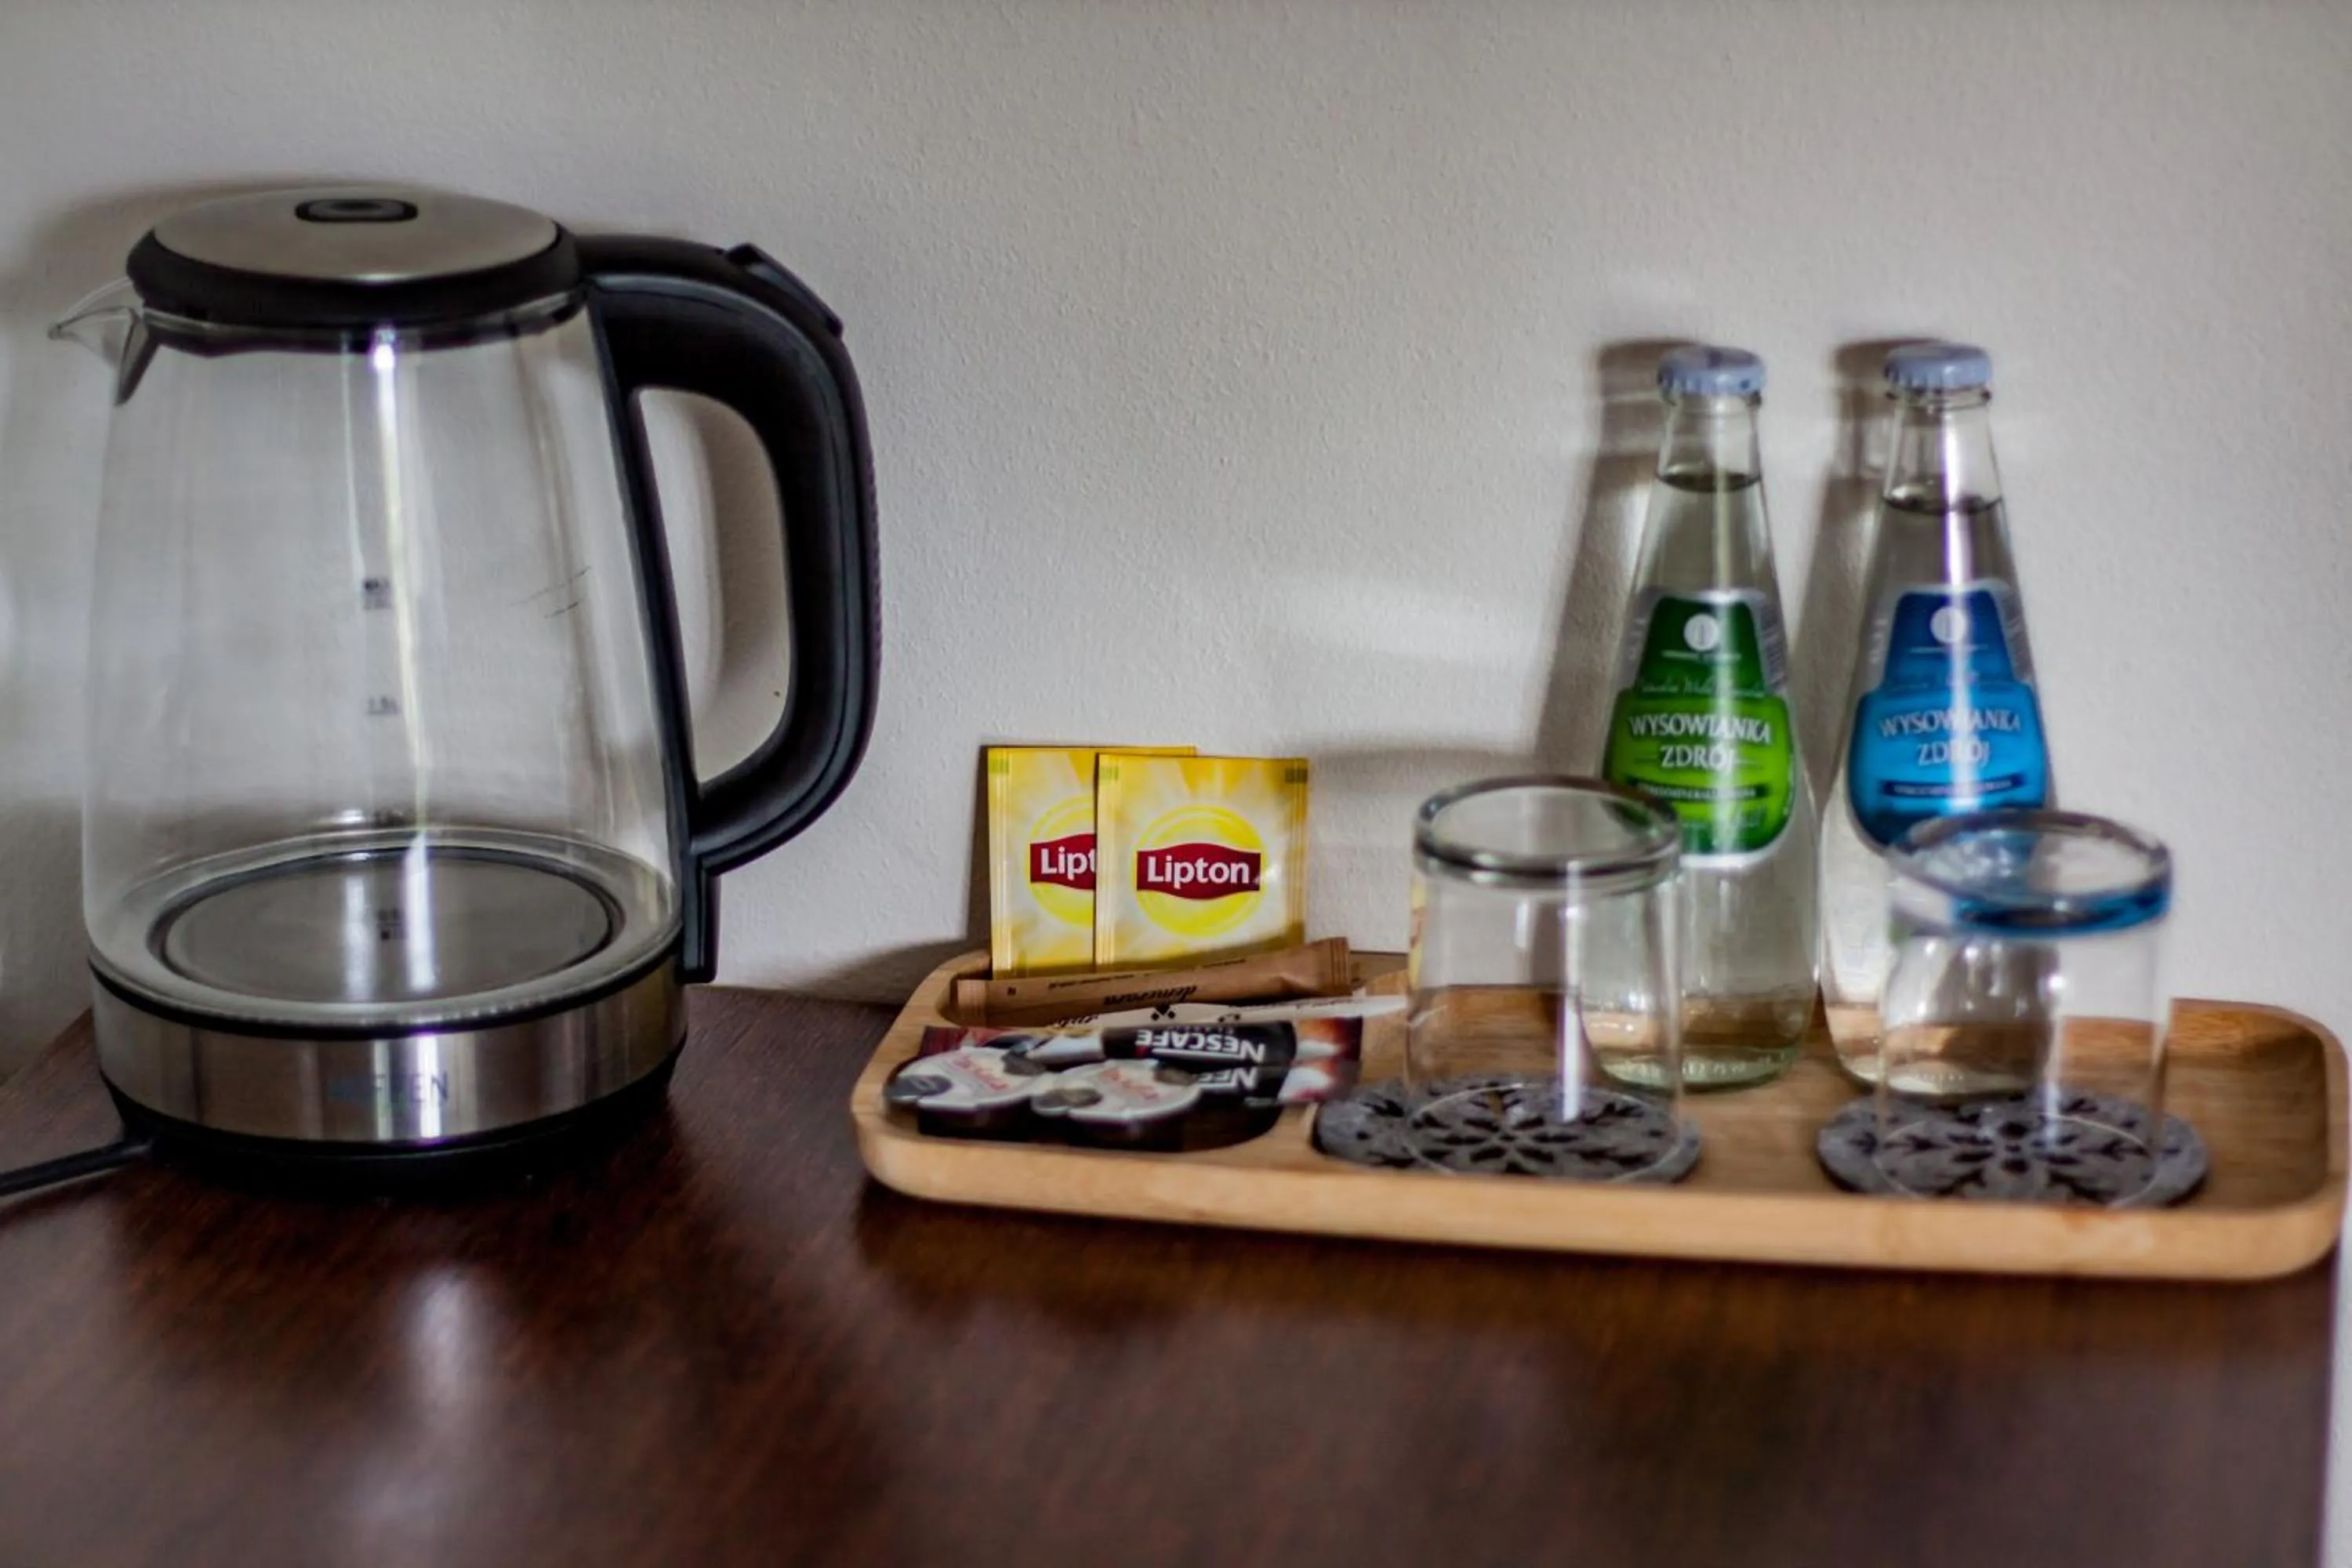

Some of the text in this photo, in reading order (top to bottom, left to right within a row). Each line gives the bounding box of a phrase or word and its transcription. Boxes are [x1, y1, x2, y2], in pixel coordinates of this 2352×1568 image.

[1629, 713, 1771, 744] WYSOWIANKA
[1878, 708, 2021, 737] WYSOWANKA
[1040, 847, 1095, 879] Lipt
[1147, 855, 1250, 888] Lipton
